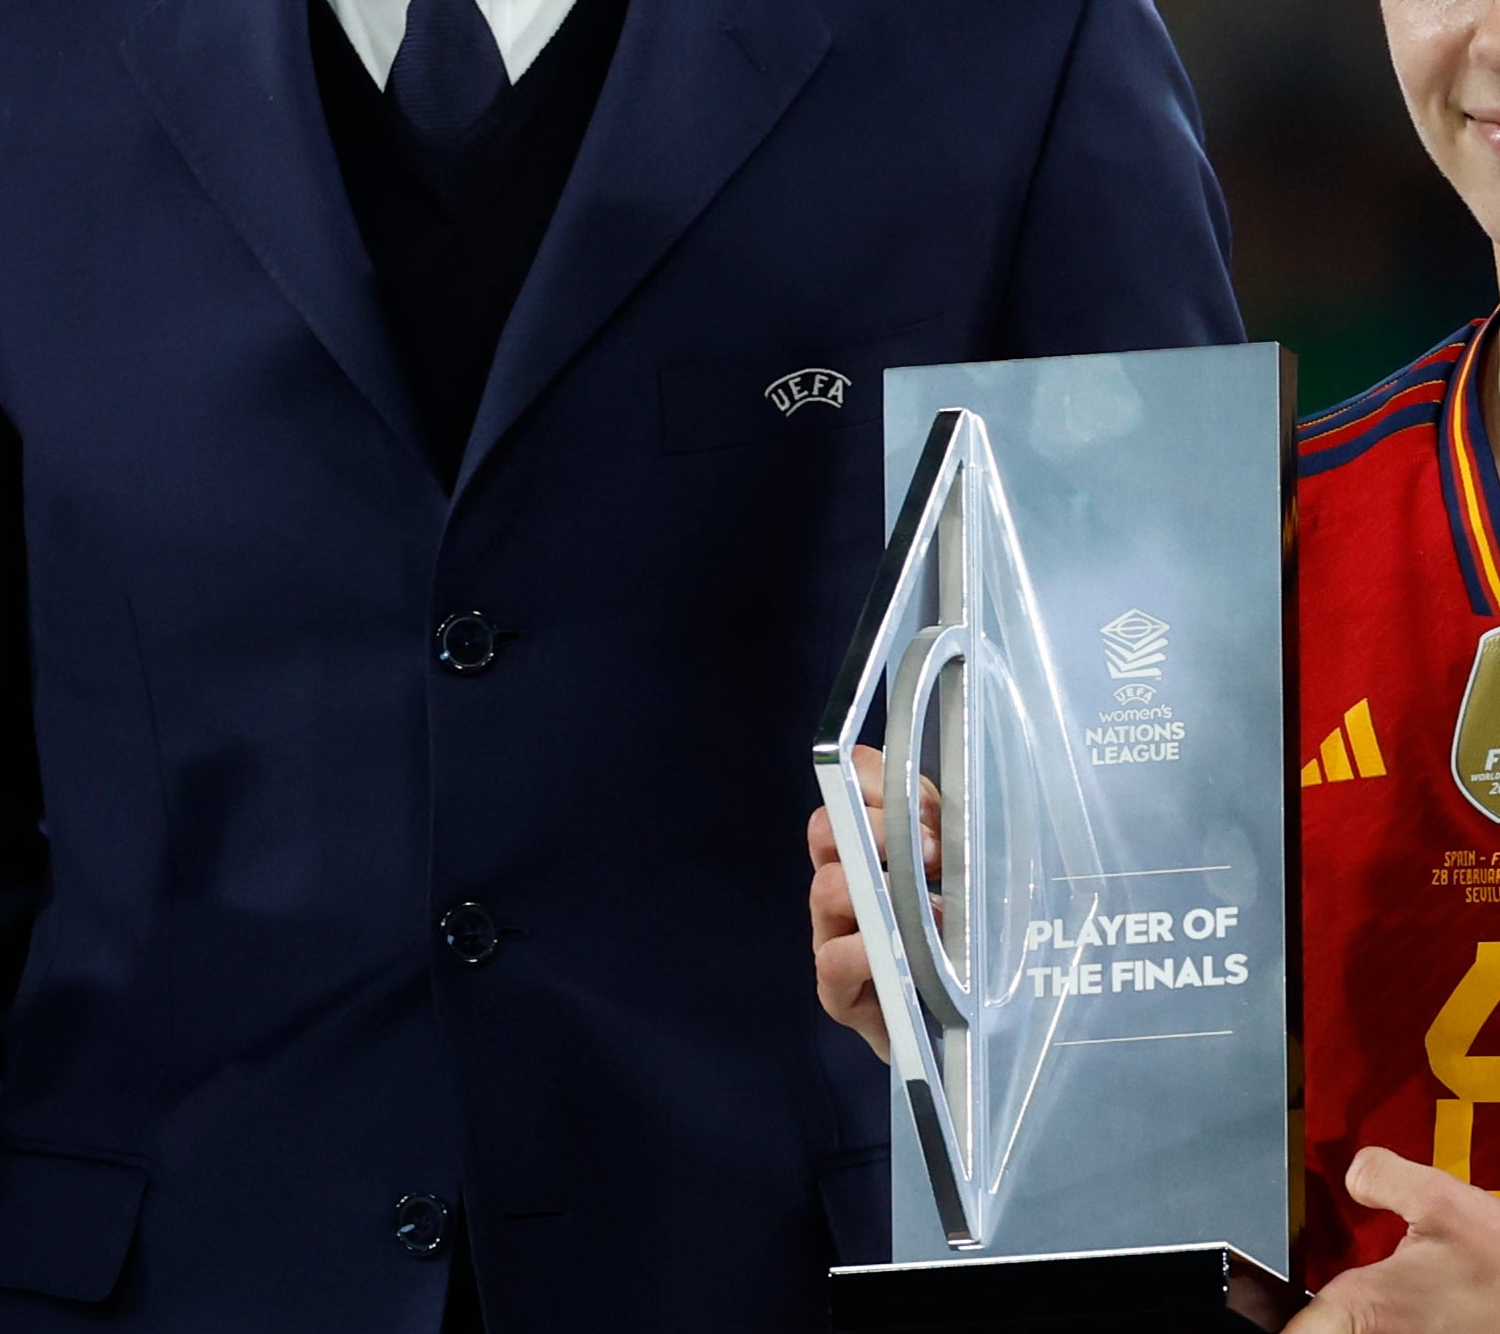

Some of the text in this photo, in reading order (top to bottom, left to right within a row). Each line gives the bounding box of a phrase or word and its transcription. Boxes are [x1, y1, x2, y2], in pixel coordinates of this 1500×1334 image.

[771, 374, 844, 411] UEFA
[1116, 687, 1153, 702] UEFA
[1099, 704, 1173, 723] women's
[1085, 722, 1186, 746] NATIONS
[1092, 742, 1180, 765] LEAGUE
[1471, 772, 1500, 782] WORLD
[1444, 851, 1476, 867] SPAIN
[1431, 869, 1449, 885] 28
[1028, 907, 1239, 951] PLAYER OF
[1027, 953, 1249, 998] THE FINALS
